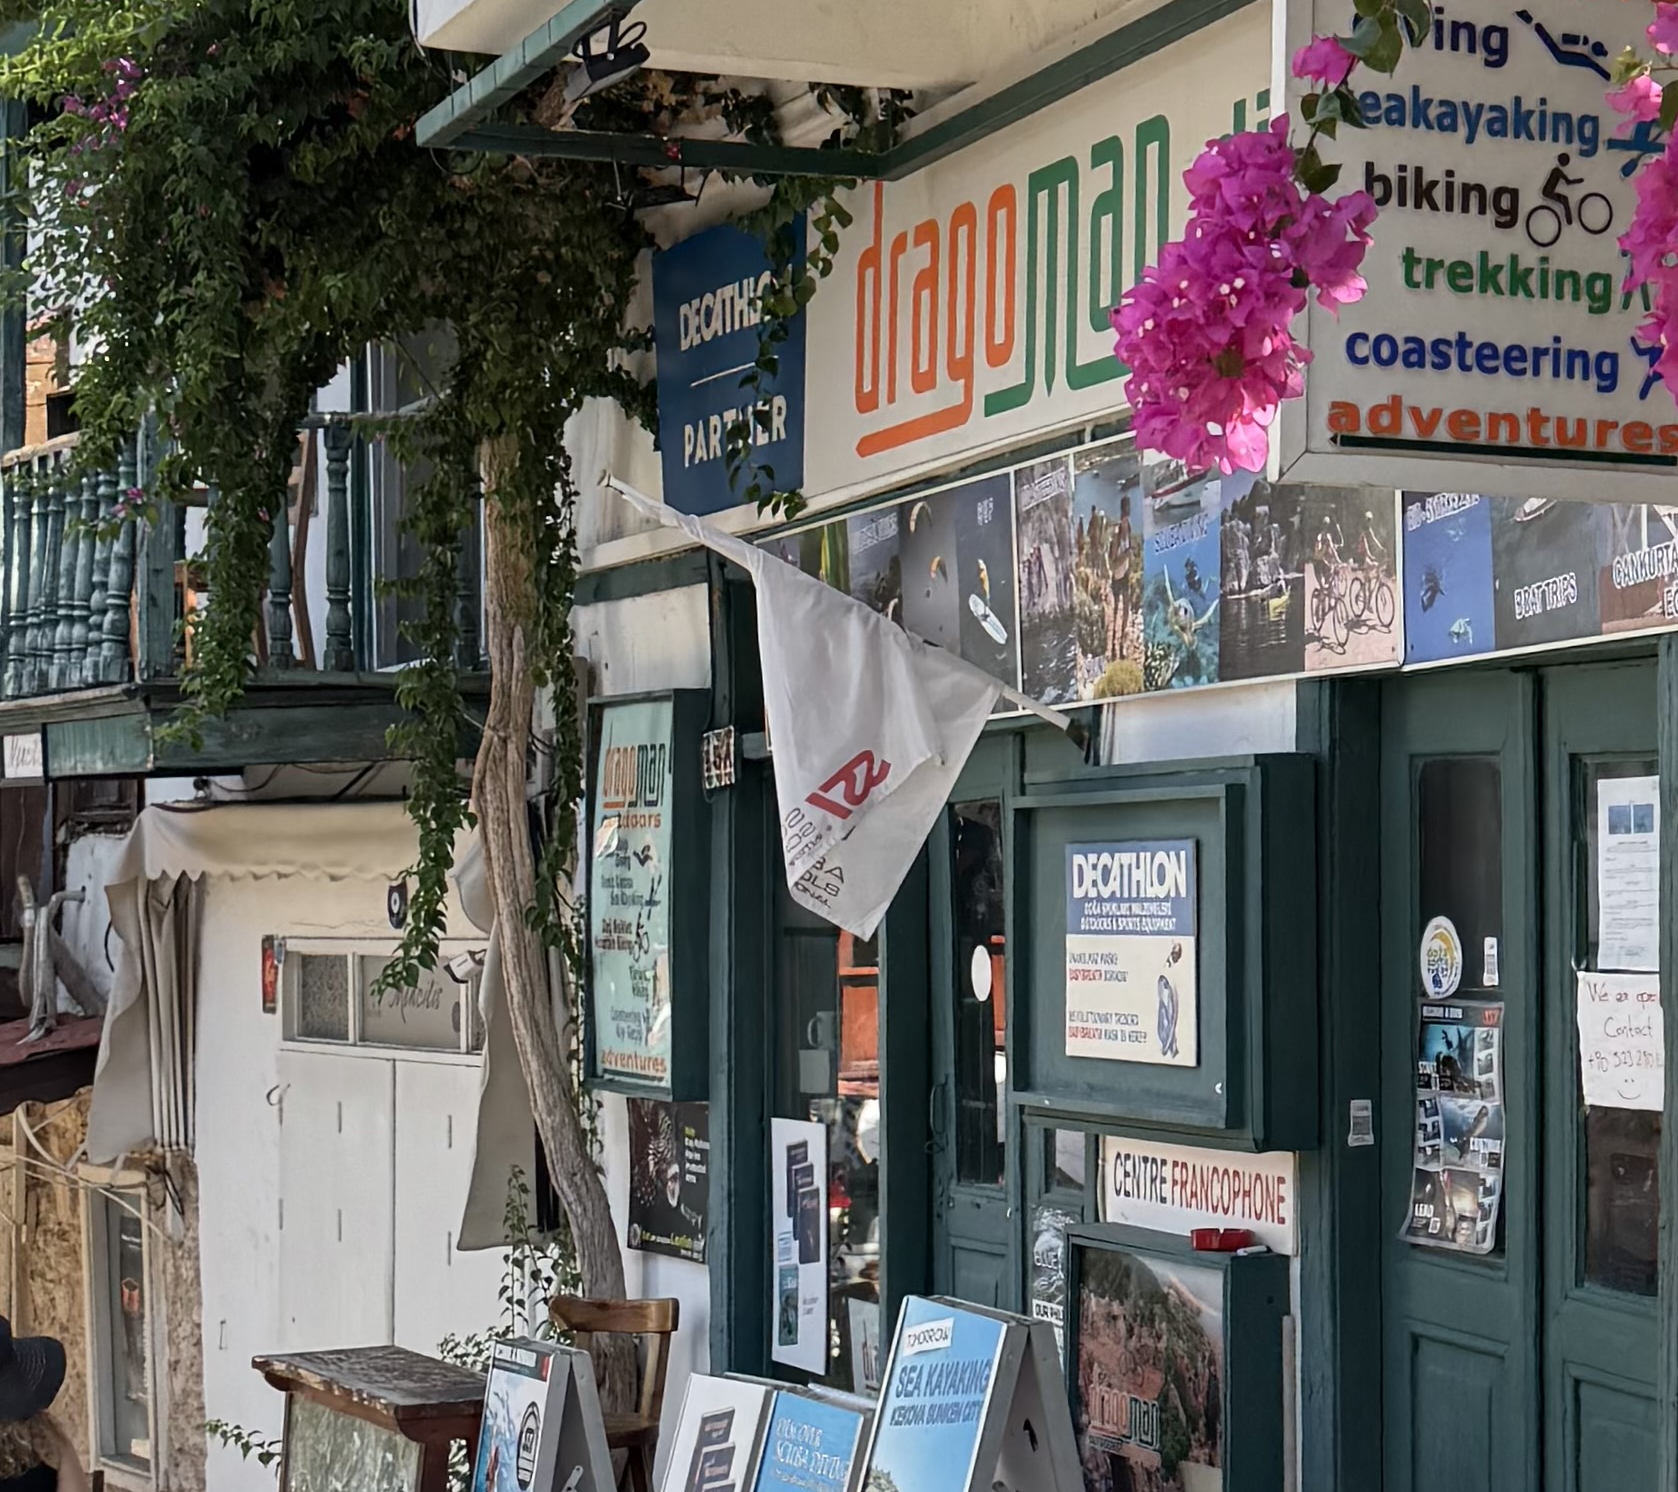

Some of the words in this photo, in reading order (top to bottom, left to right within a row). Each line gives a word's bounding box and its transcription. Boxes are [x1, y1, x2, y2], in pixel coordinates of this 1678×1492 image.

[1359, 85, 1600, 158] eakayaking
[1364, 161, 1520, 229] biking
[1402, 246, 1613, 315] trekking
[1345, 331, 1620, 394] coasteering
[1073, 850, 1187, 899] DECATHLON
[1113, 1151, 1168, 1205] CENTRE
[1171, 1159, 1287, 1226] FRANCOPHONE
[895, 1364, 924, 1398] SEA
[923, 1359, 991, 1398] KAYAKING
